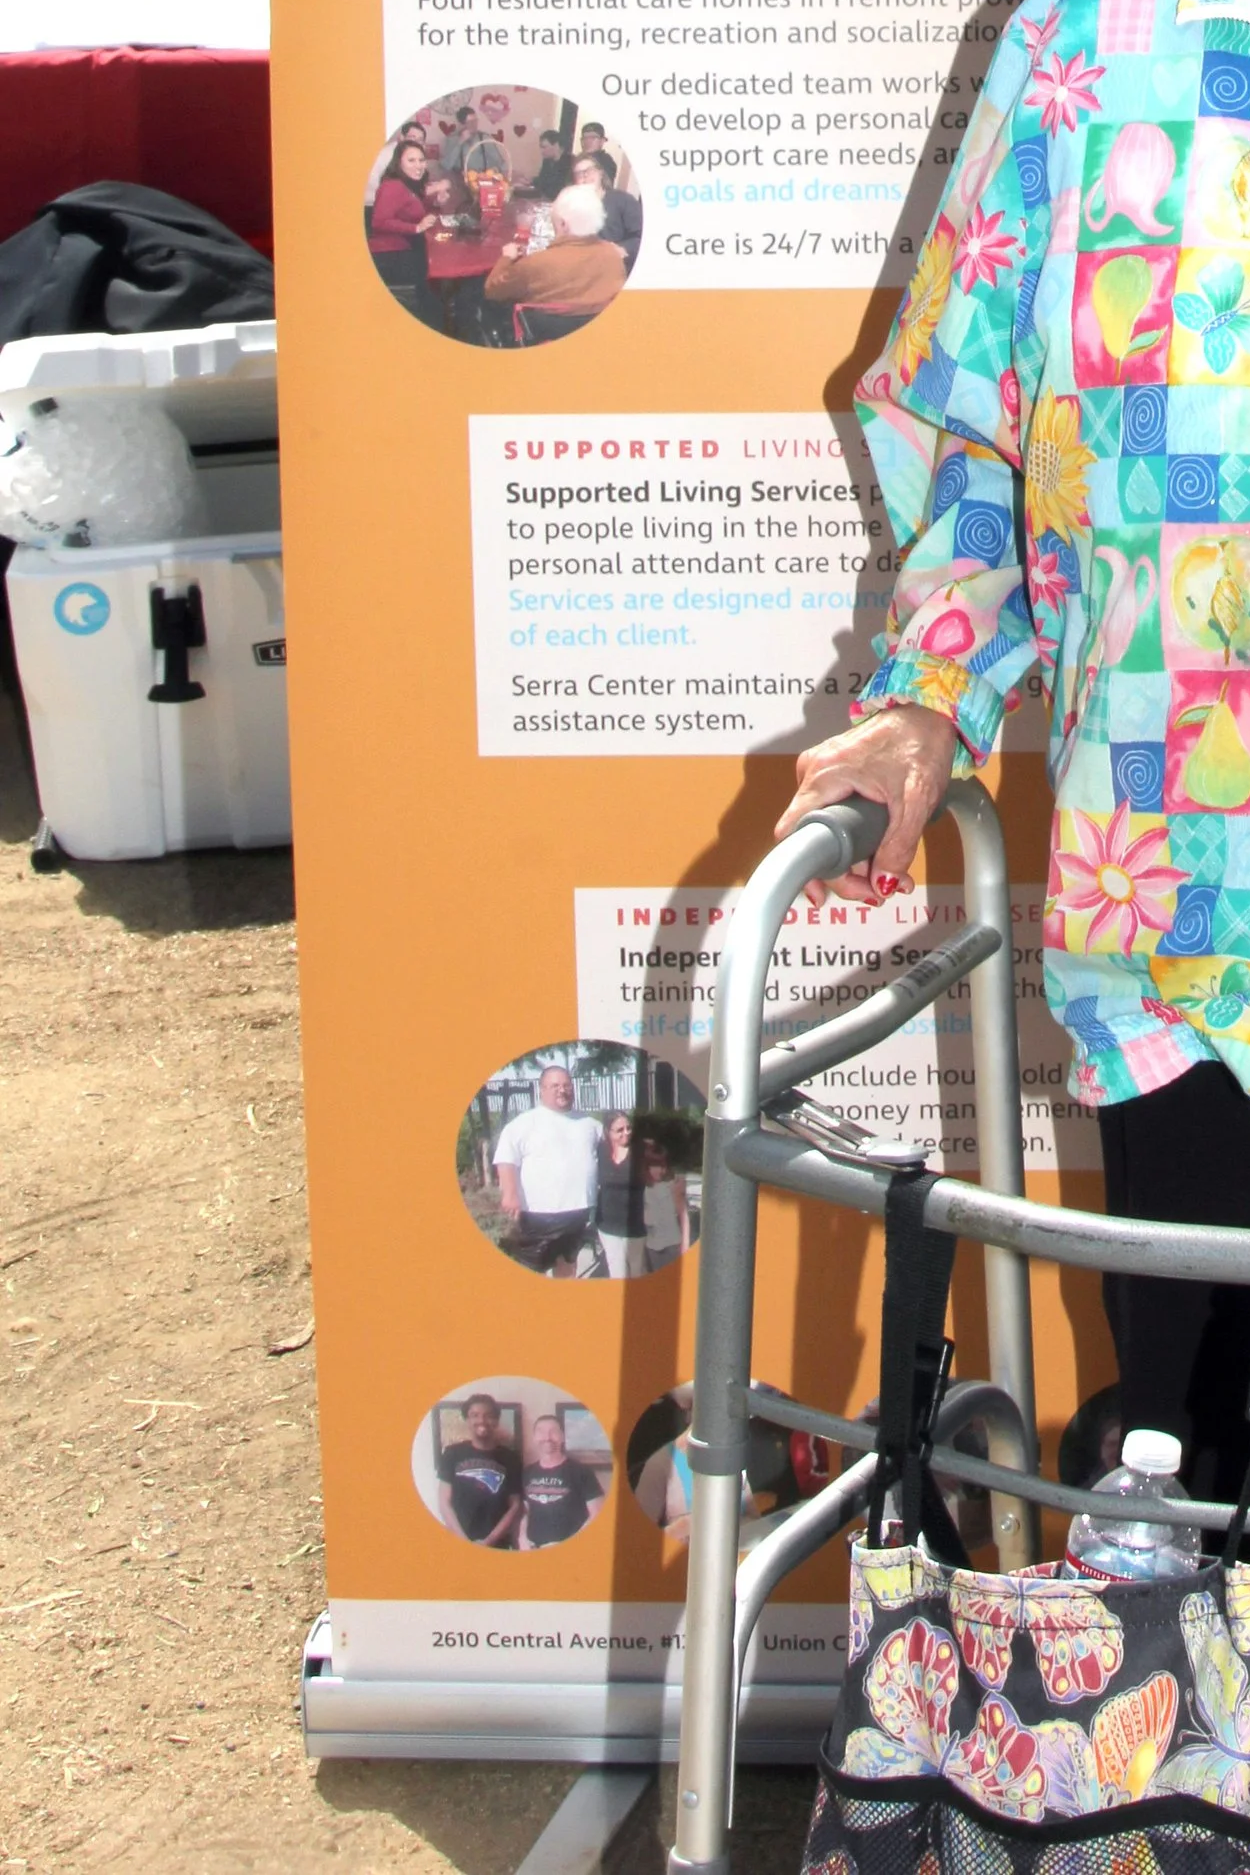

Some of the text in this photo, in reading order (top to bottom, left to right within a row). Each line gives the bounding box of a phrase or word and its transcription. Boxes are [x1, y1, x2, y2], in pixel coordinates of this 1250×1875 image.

[418, 20, 1001, 50] for the training, recreation and socializatio
[602, 74, 651, 96] Our
[661, 72, 792, 95] dedicated
[803, 74, 871, 94] team
[882, 71, 960, 94] works
[638, 111, 666, 131] to
[676, 108, 781, 136] develop
[791, 114, 805, 130] a
[816, 107, 931, 136] personal
[660, 145, 763, 172] support
[773, 149, 828, 166] care
[840, 142, 923, 167] needs,
[664, 180, 734, 208] goals
[745, 179, 793, 201] and
[666, 234, 725, 256] Care
[735, 232, 753, 256] is
[763, 229, 821, 258] 24/7
[832, 230, 889, 255] with
[899, 237, 914, 254] a
[504, 440, 719, 460] SUPPORTED
[507, 480, 649, 509] Supported
[661, 480, 741, 507] Living
[752, 479, 861, 502] Services
[507, 515, 882, 544] to people living in the home
[510, 552, 622, 580] personal
[632, 551, 765, 574] attendant
[775, 557, 829, 573] care
[839, 553, 866, 573] to
[510, 589, 614, 610] Services
[624, 593, 663, 610] are
[673, 587, 791, 615] designed
[510, 623, 696, 646] of each client.
[512, 675, 578, 696] Serra
[588, 675, 675, 696] Center
[686, 673, 815, 696] maintains
[824, 679, 839, 696] a
[513, 710, 753, 736] assistance system.
[617, 906, 967, 926] INDEPDENT LIVIN
[620, 946, 791, 972] Indepennt
[802, 946, 881, 971] Living
[902, 1012, 971, 1036] ossibl
[823, 1064, 917, 1086] include
[927, 1063, 1062, 1086] houold
[433, 1632, 479, 1648] 2610
[486, 1632, 562, 1648] Central
[570, 1632, 653, 1653] Avenue,
[764, 1634, 825, 1651] Union
